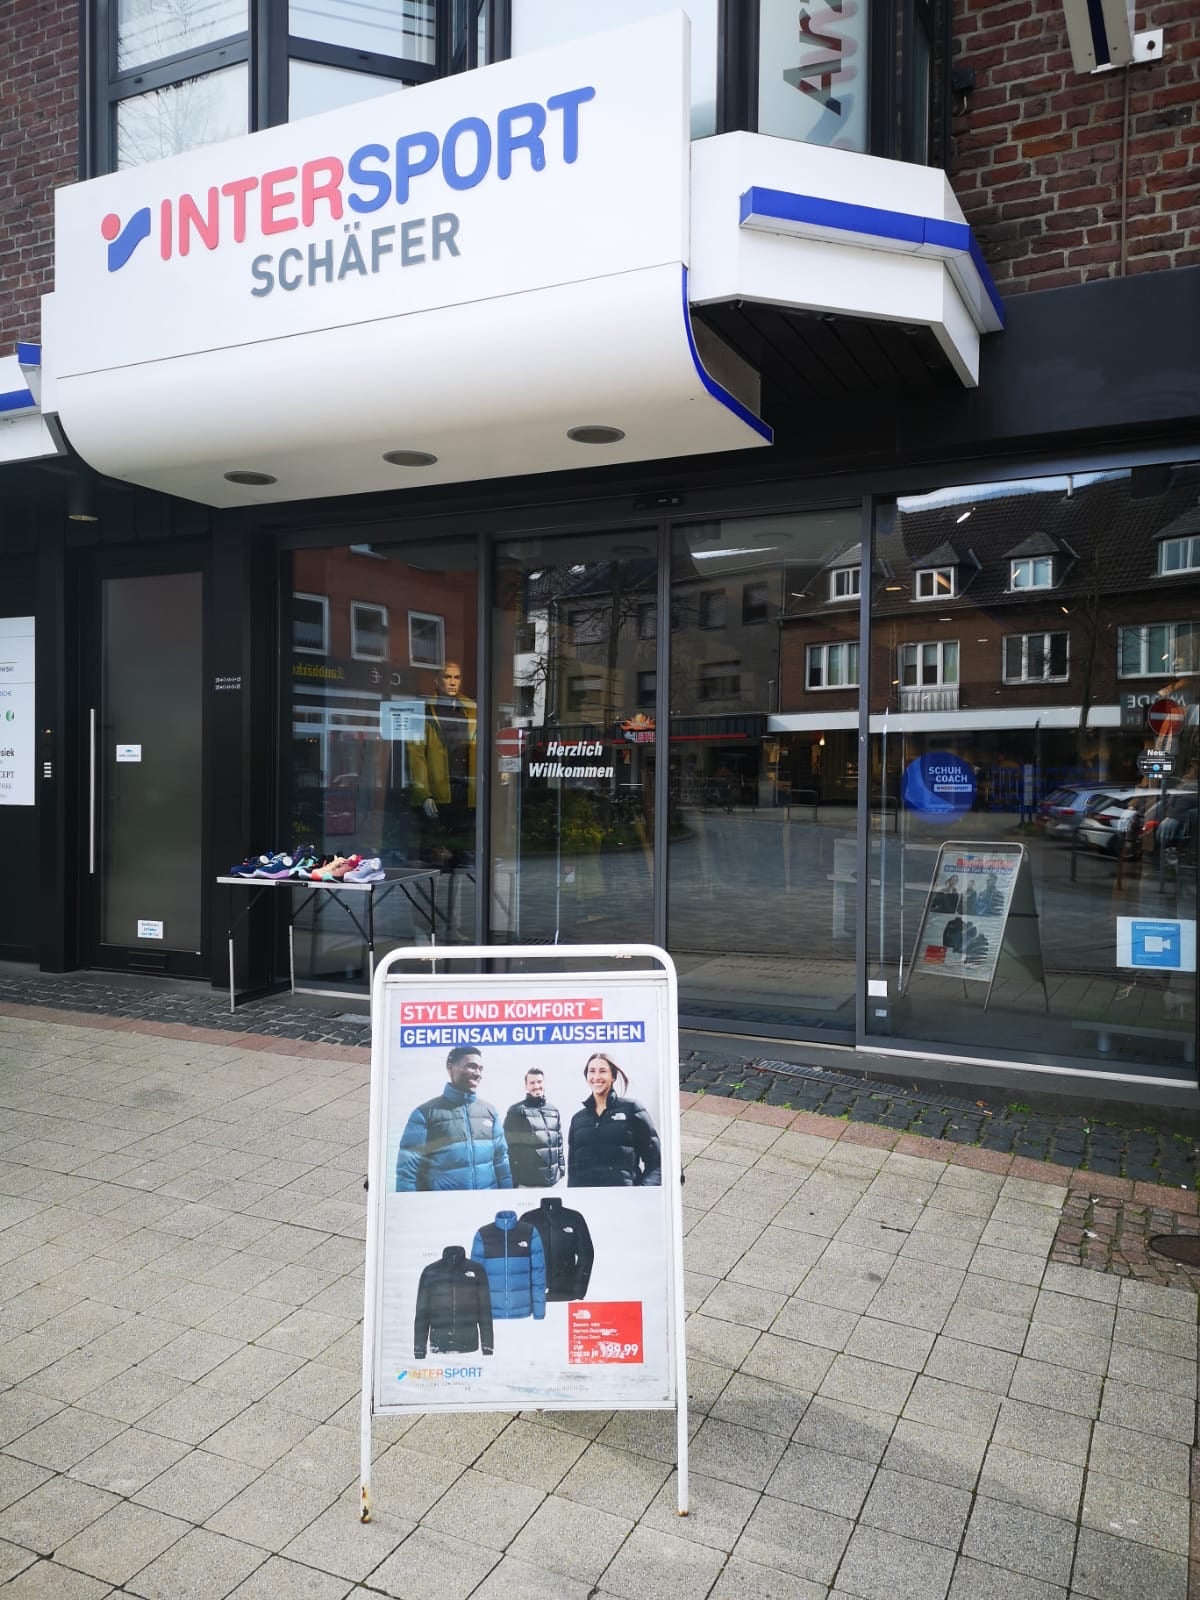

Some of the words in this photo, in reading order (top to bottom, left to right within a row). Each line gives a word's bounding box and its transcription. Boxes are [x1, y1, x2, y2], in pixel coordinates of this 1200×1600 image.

[160, 86, 596, 260] INTERSPORT
[251, 213, 461, 298] SCHÄFER
[546, 741, 603, 757] Herzlich
[529, 762, 614, 778] Willkommen
[928, 766, 961, 775] SCHUH
[935, 774, 968, 783] COACH
[403, 1004, 458, 1020] STYLE
[463, 1003, 499, 1019] UND
[504, 1001, 586, 1018] KOMFORT
[403, 1027, 507, 1045] GEMEINSAM
[512, 1026, 547, 1042] GUT
[550, 1024, 642, 1041] AUSSEHEN
[408, 1367, 483, 1380] INTERSPORT
